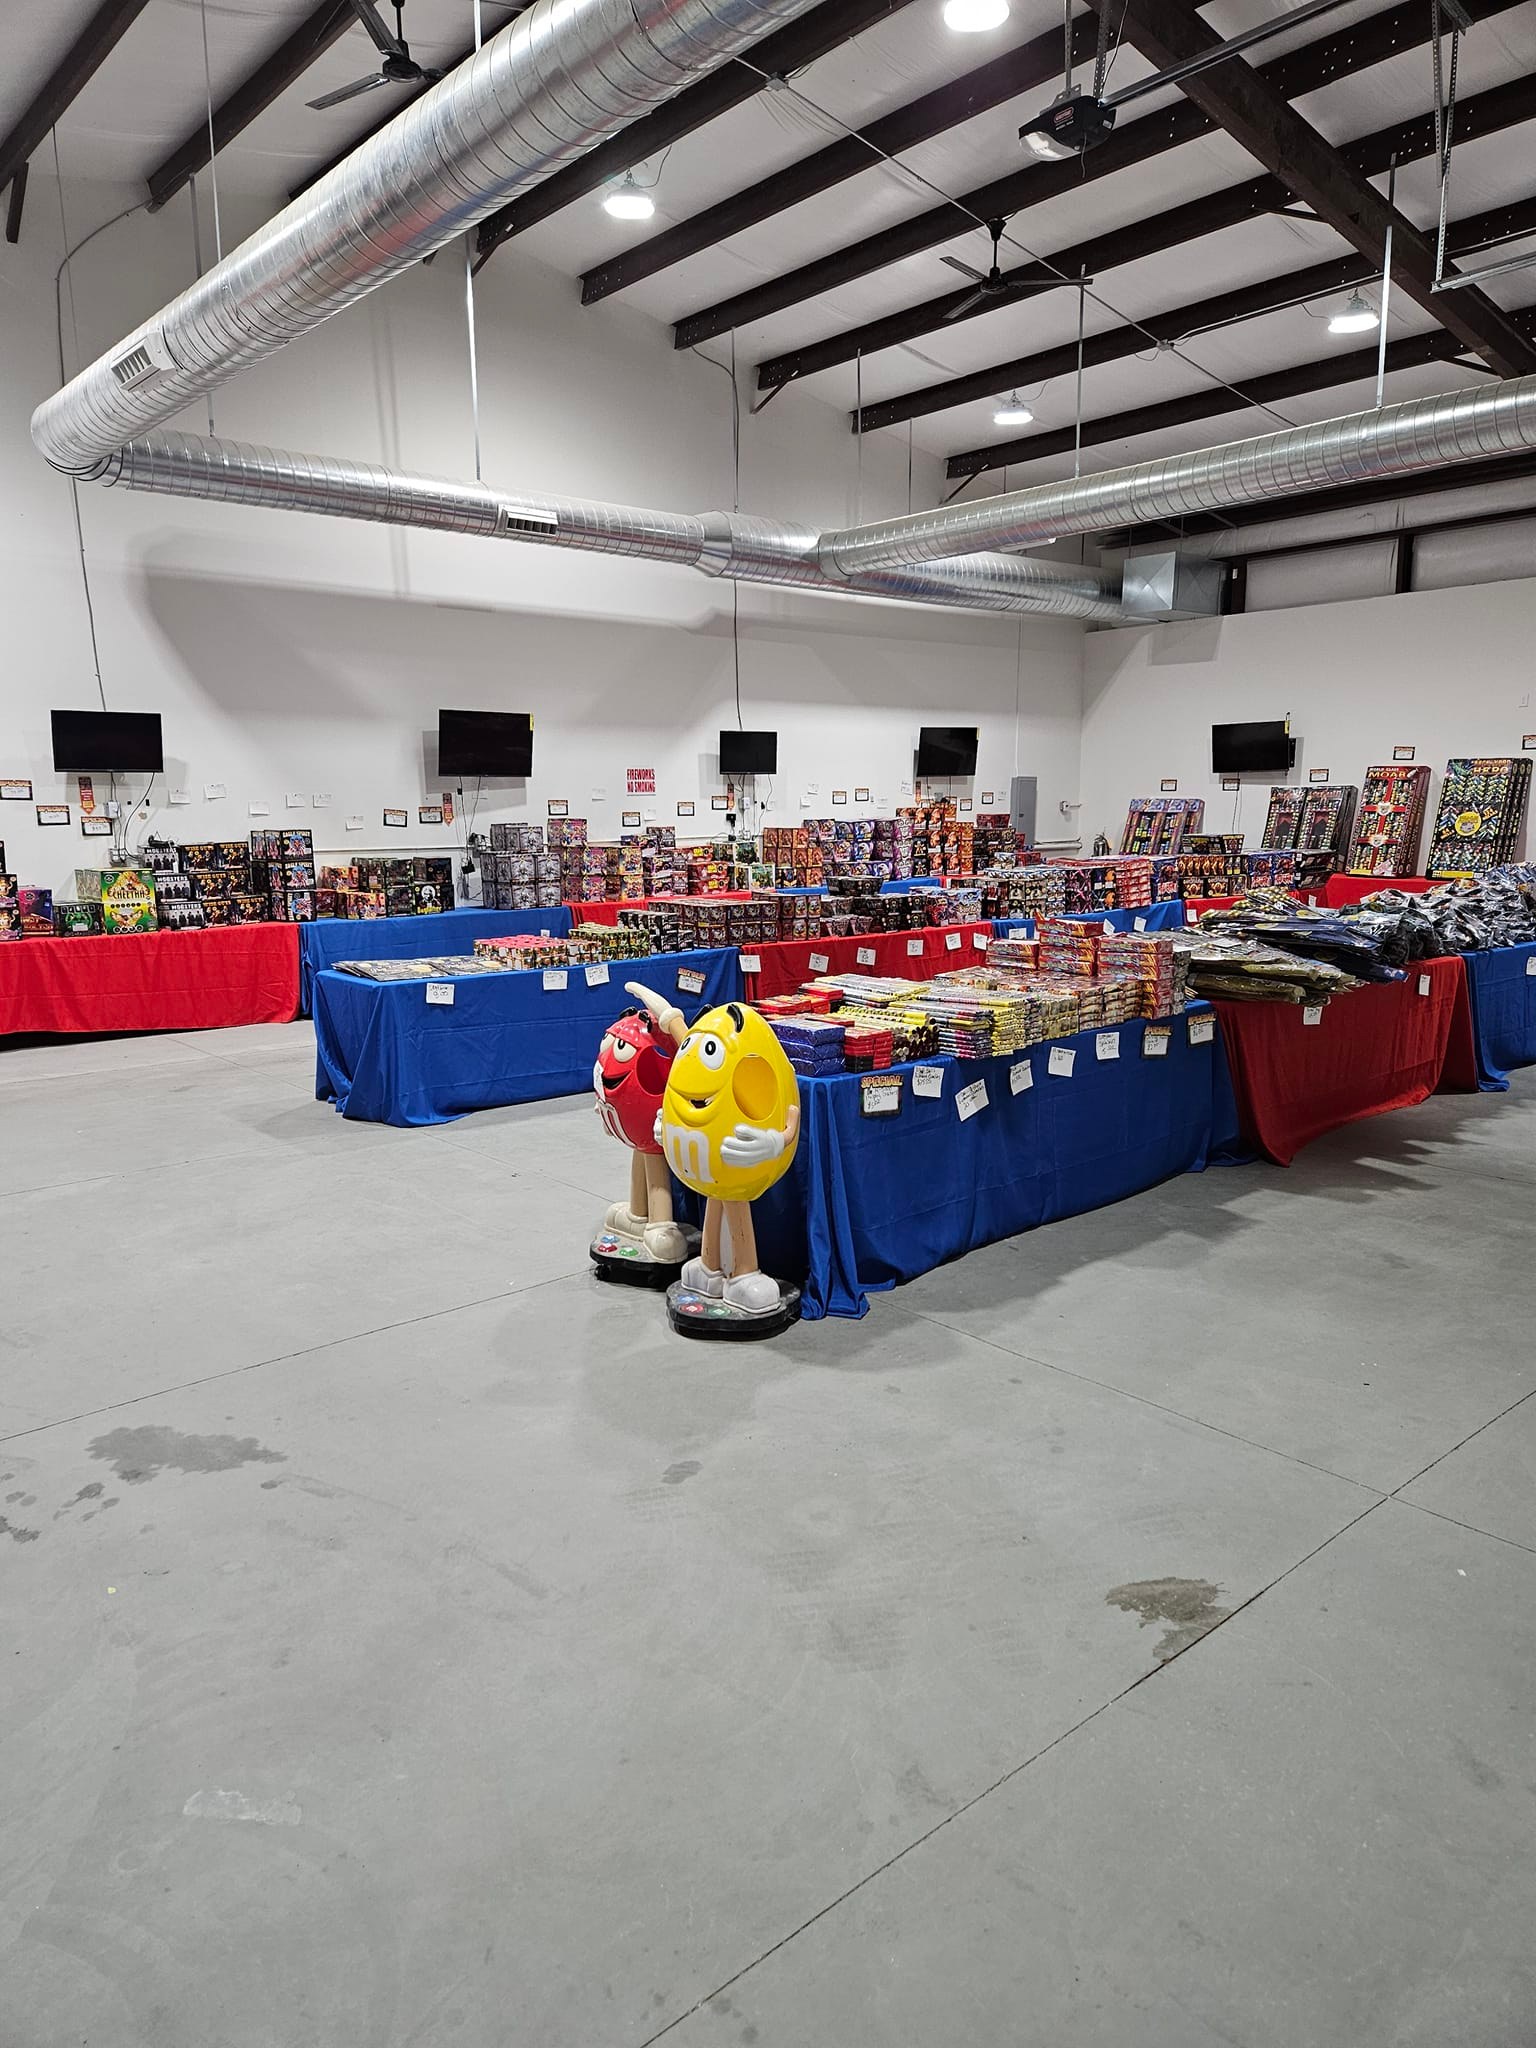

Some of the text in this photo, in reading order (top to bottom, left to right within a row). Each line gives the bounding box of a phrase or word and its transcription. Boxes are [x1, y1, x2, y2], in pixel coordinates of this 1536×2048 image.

[627, 768, 655, 780] FIREWORKS
[627, 781, 656, 793] NO SMOKING
[113, 888, 145, 899] CHEETAH
[861, 1075, 903, 1089] SPECIAL
[665, 1123, 715, 1183] m
